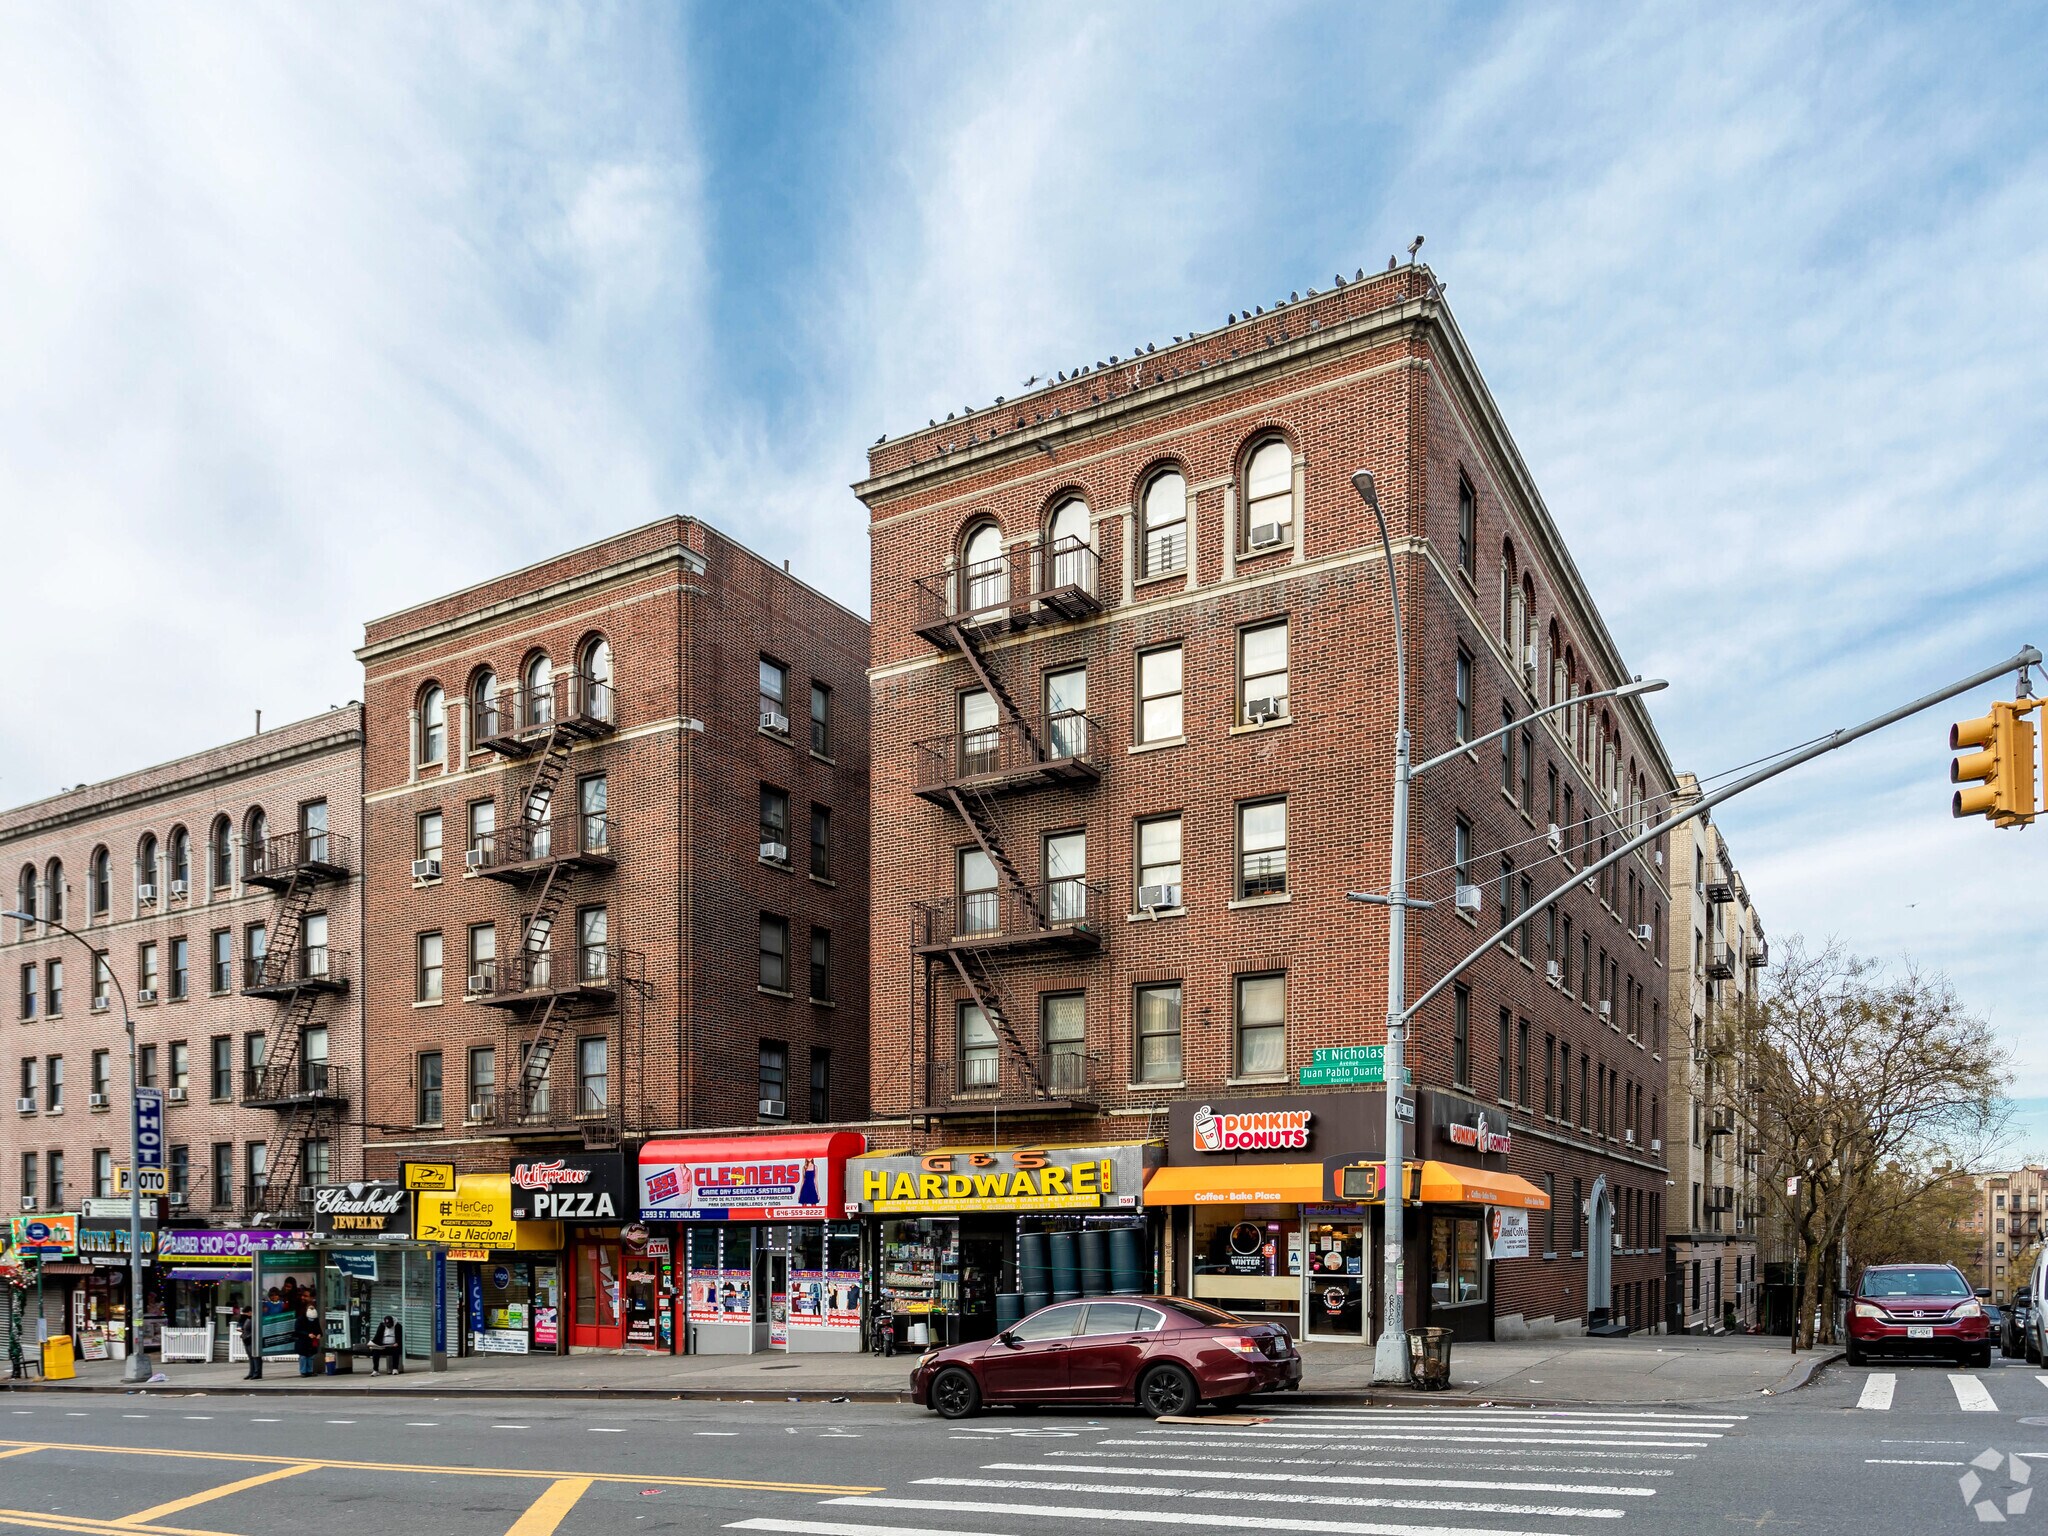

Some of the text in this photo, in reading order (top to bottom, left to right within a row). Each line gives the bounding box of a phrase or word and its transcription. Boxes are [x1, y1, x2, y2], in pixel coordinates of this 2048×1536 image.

[1315, 1047, 1383, 1061] St Nicholas
[1303, 1066, 1382, 1078] Juan Pablo Duarte
[1225, 1112, 1309, 1131] DUNKIN'
[138, 1099, 160, 1168] PHOT
[1225, 1130, 1305, 1148] DONUTS
[921, 1150, 1046, 1172] G & S
[647, 1171, 677, 1195] 1593
[694, 1164, 800, 1186] CLEANERS
[863, 1161, 1097, 1200] HARDWARE
[1366, 1173, 1374, 1193] 5
[316, 1188, 404, 1214] Elizabeth
[1194, 1191, 1281, 1200] Coffee Bake Place
[455, 1201, 493, 1214] HerCep
[534, 1193, 616, 1217] PIZZA
[332, 1216, 385, 1230] JEWELRY
[642, 1210, 700, 1219] 1593 ST. NICHOLAS
[80, 1229, 112, 1251] CIFRE
[115, 1230, 153, 1253] PHTO
[448, 1228, 513, 1240] La Nacional
[172, 1237, 222, 1254] BARBER SHOP
[469, 1250, 485, 1258] TAX
[649, 1244, 668, 1253] ATM
[1290, 1252, 1298, 1261] A
[494, 1272, 508, 1281] vigo
